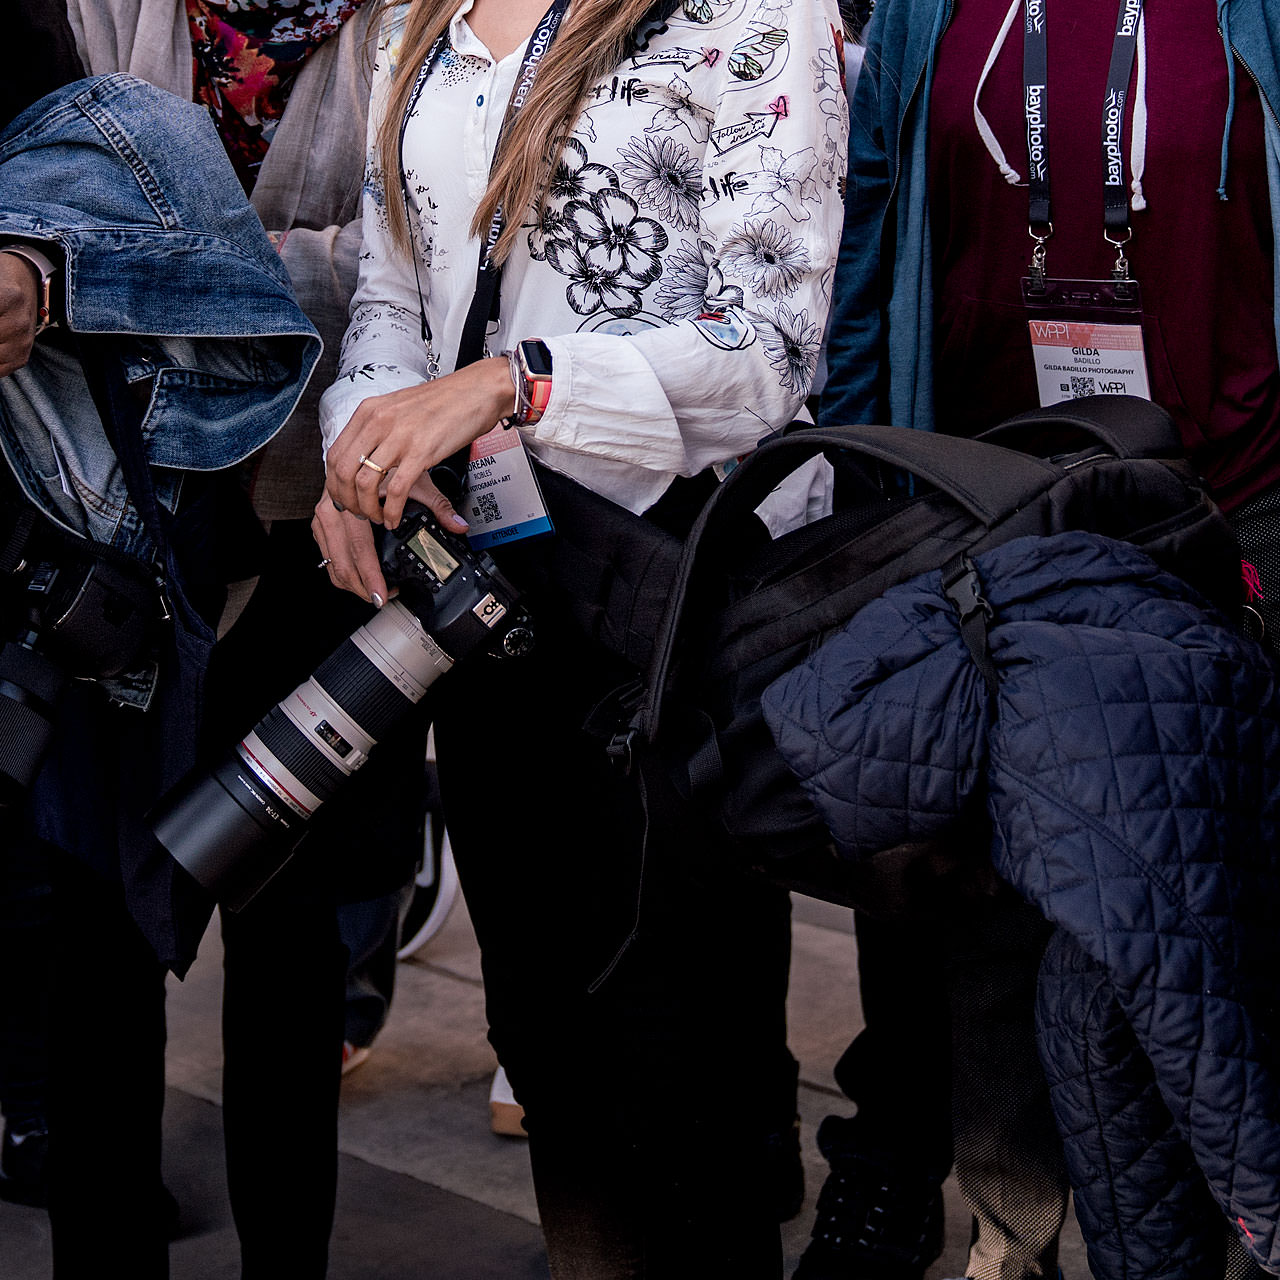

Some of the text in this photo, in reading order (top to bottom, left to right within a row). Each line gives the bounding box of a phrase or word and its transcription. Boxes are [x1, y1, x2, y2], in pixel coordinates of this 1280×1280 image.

[1032, 322, 1070, 340] WPPI
[1071, 346, 1101, 357] GILDA
[1073, 357, 1102, 366] BADILLO
[1043, 364, 1135, 376] GILDA BADILLO PHOTOGRAPHY
[1098, 381, 1127, 394] WPPI
[466, 455, 497, 472] DREANA
[473, 469, 493, 480] ROBLES
